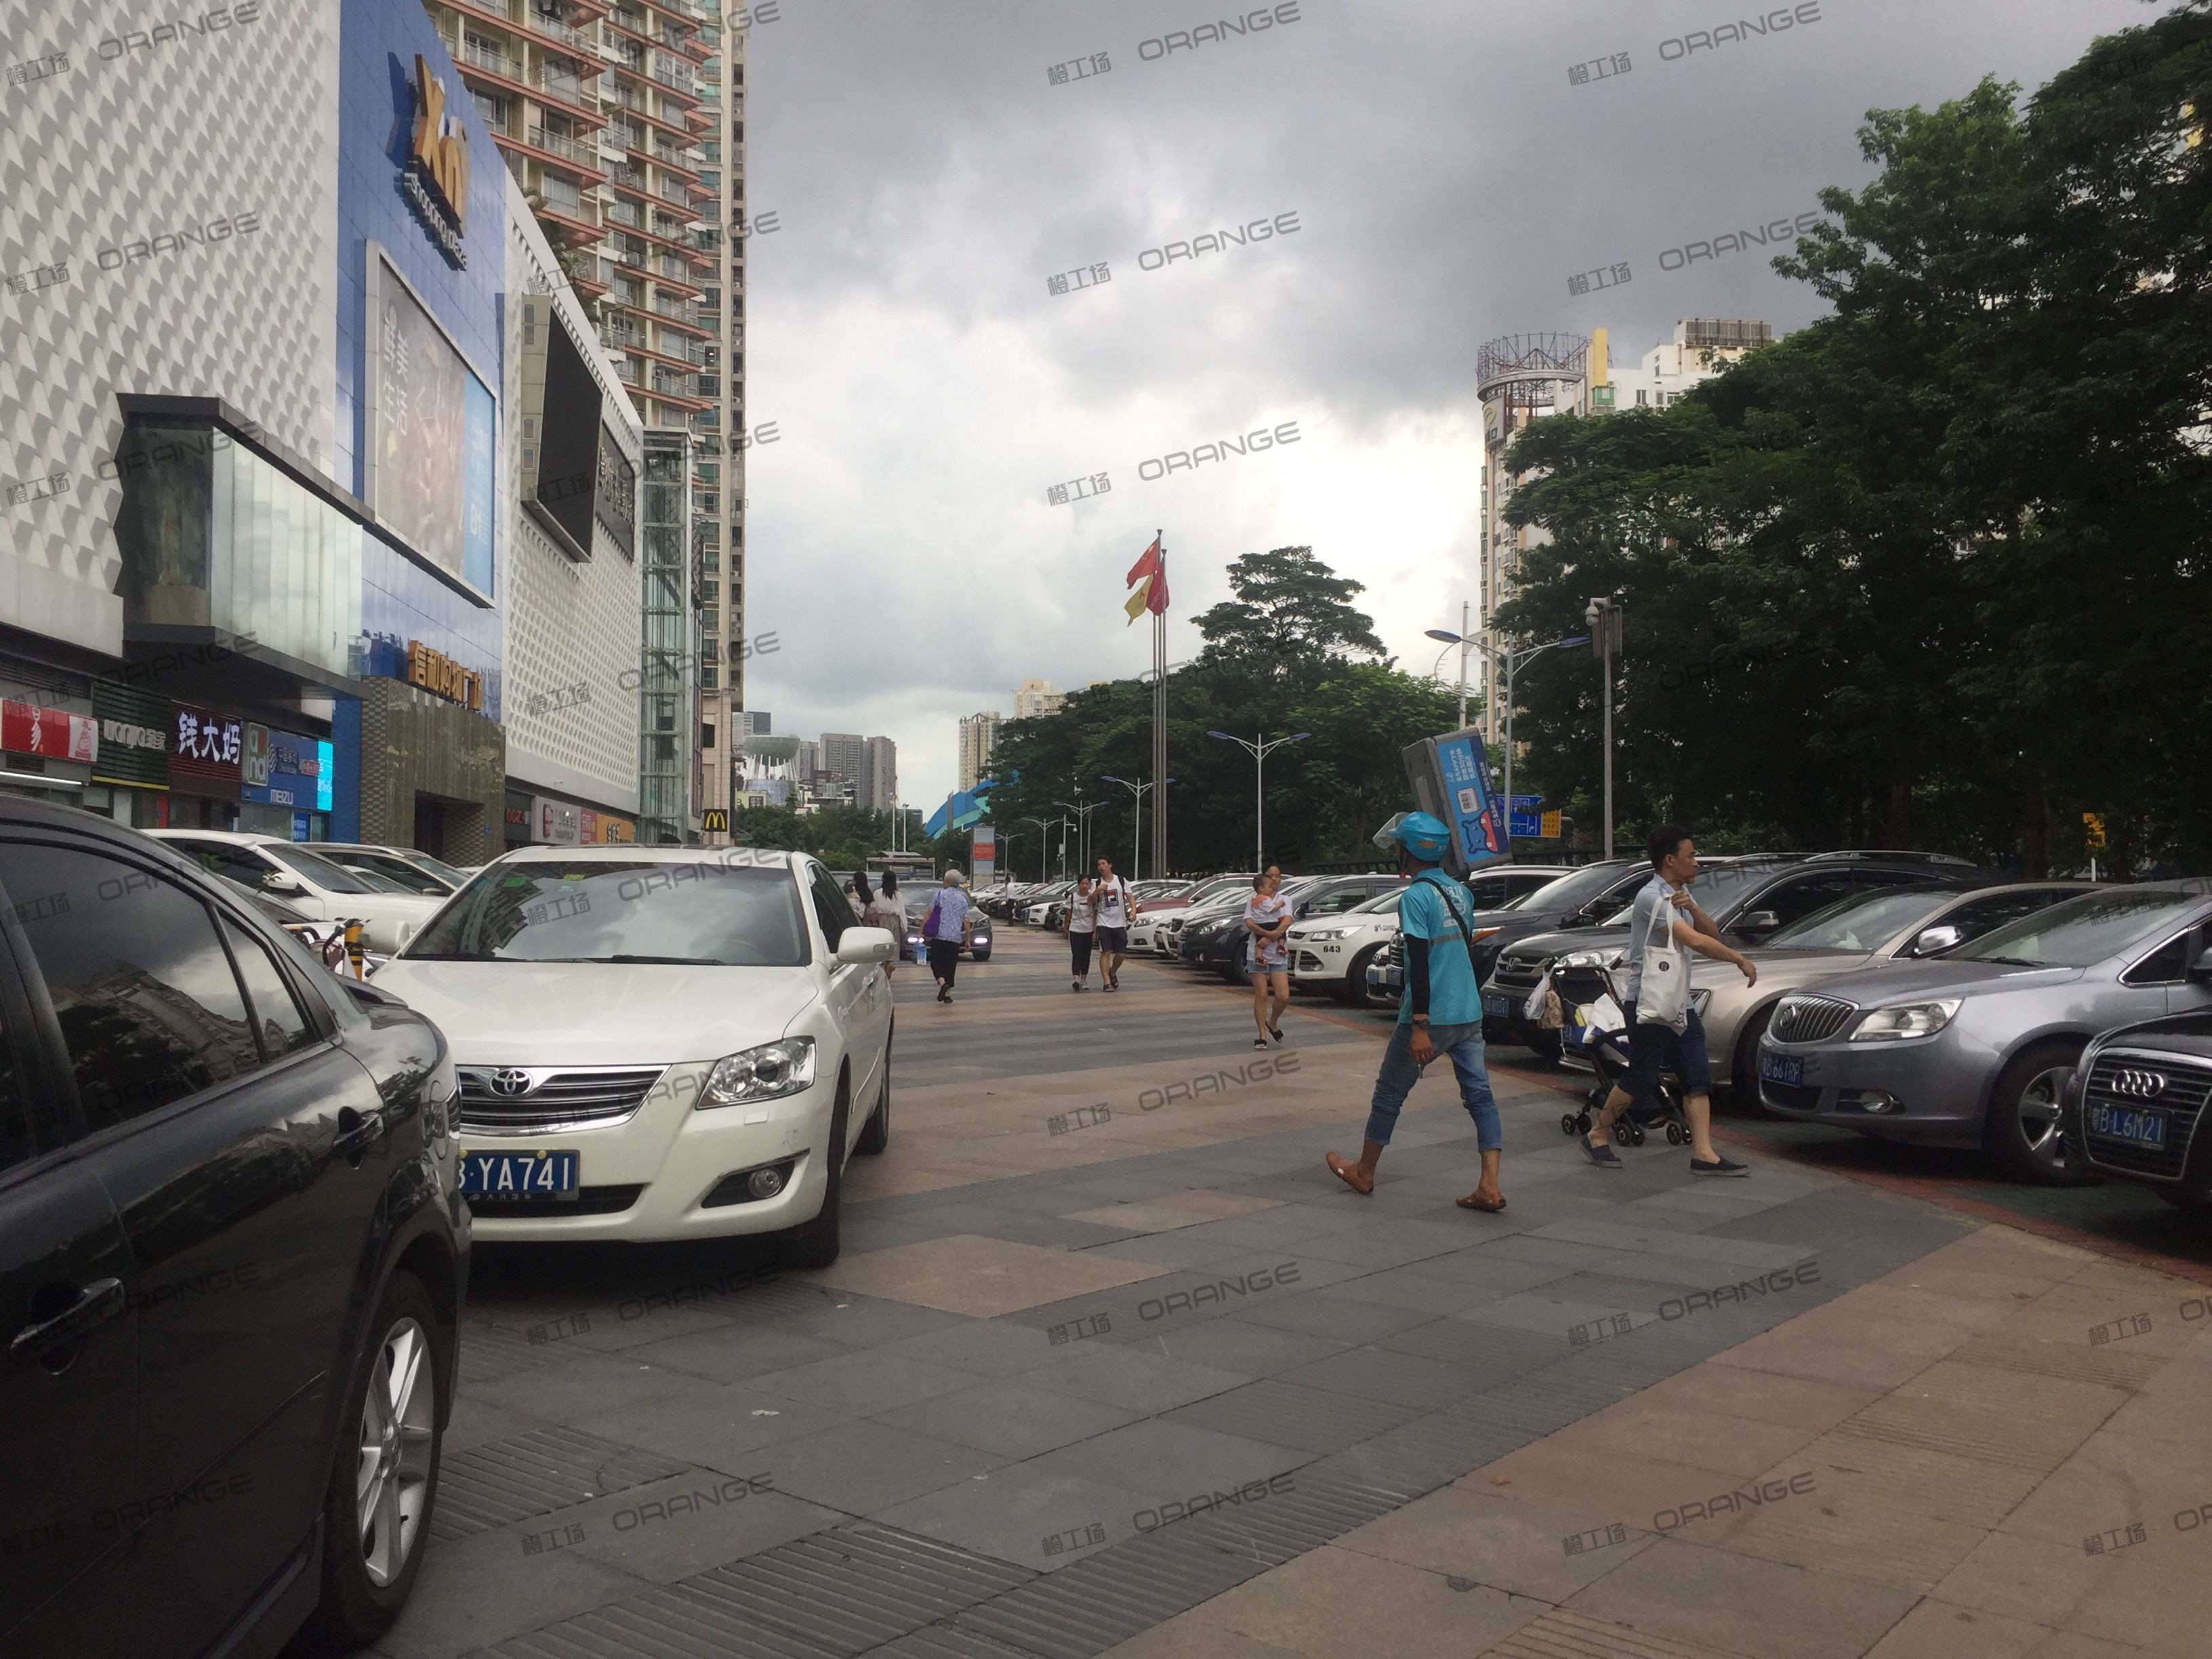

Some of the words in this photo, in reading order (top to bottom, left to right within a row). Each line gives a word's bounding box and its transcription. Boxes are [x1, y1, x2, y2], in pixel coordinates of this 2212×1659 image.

[178, 711, 241, 765] 钱大妈
[270, 788, 293, 806] MEIZU
